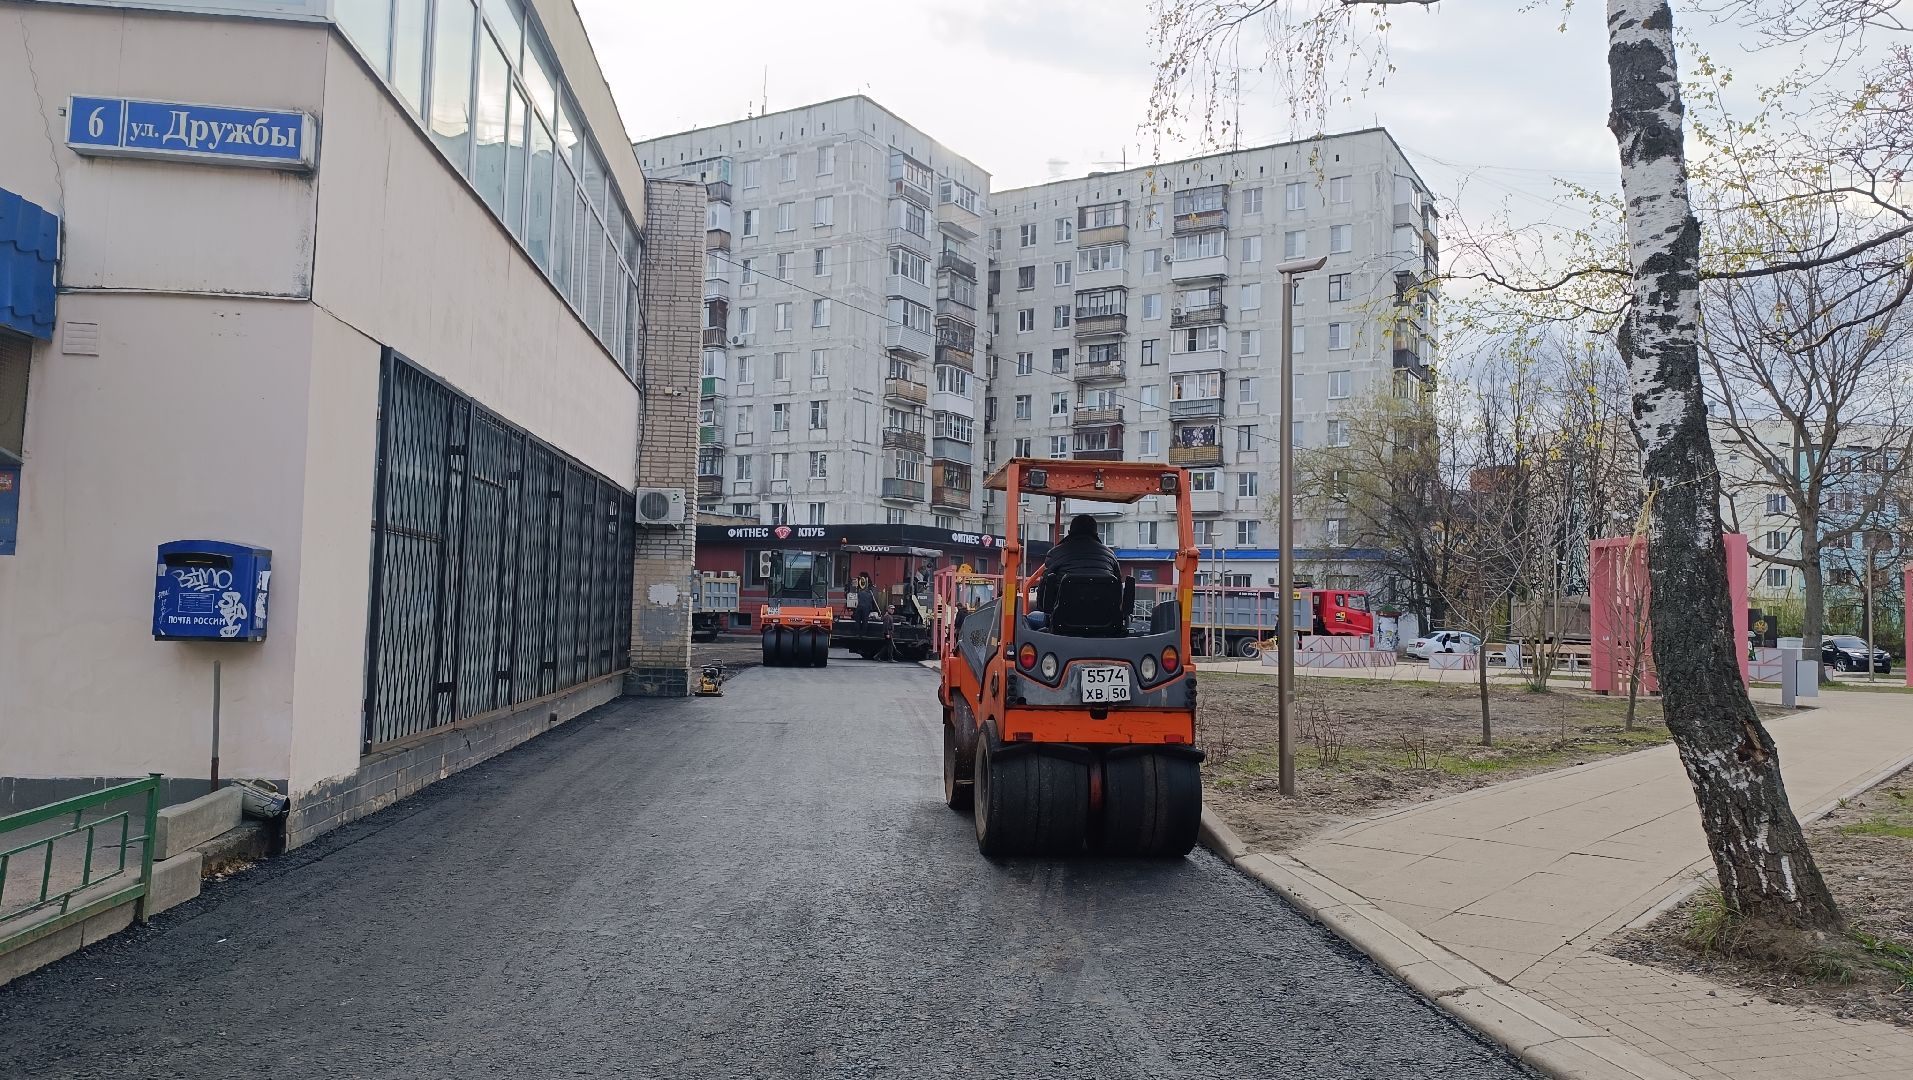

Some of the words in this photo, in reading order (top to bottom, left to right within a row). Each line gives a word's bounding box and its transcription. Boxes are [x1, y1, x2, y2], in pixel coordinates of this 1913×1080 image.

[88, 106, 105, 138] 6
[129, 120, 159, 142] ул.
[162, 110, 297, 150] Дружбы
[727, 528, 769, 538] ФИТНЕС
[797, 527, 826, 537] КЛУБ
[168, 615, 192, 625] ПОЧТА
[193, 616, 226, 626] РОССИИ
[1087, 668, 1124, 683] 5574
[1112, 687, 1127, 699] 50
